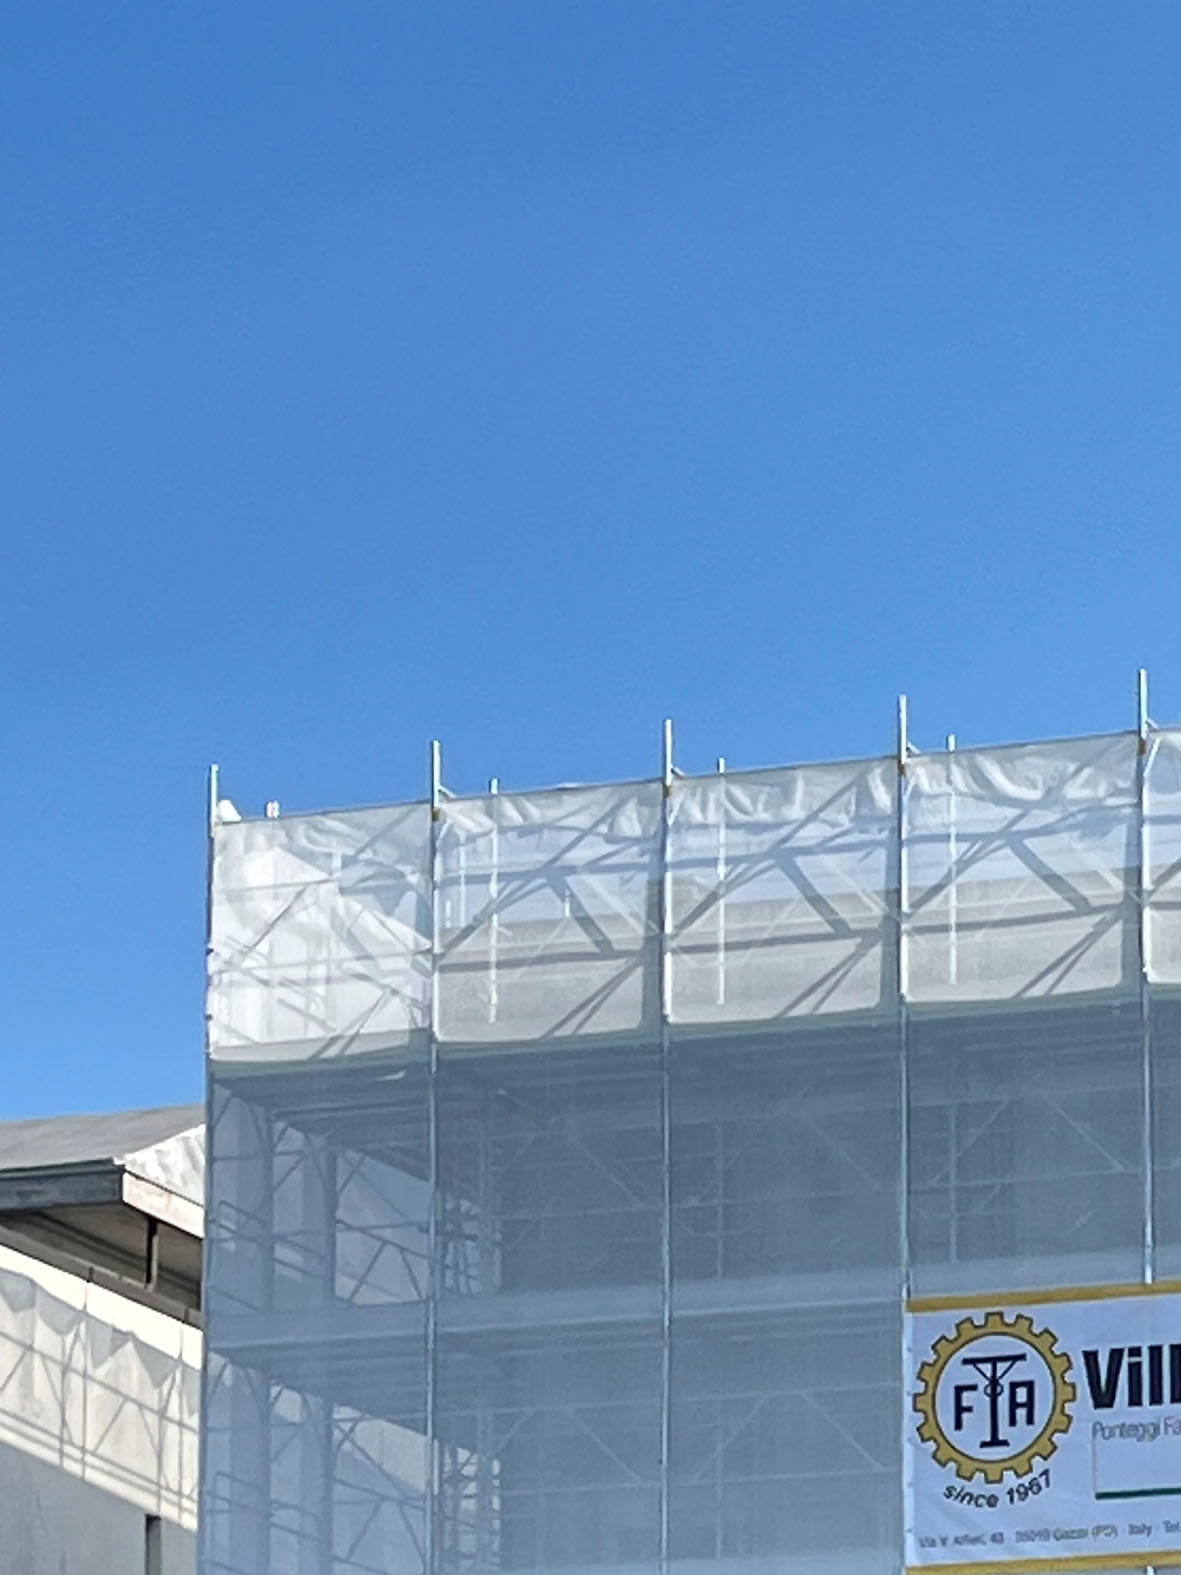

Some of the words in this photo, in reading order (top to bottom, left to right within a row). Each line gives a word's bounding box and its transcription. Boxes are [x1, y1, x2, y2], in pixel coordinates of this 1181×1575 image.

[1092, 1419, 1160, 1442] Ponteggi
[943, 1485, 999, 1508] since
[1006, 1468, 1051, 1505] 1967
